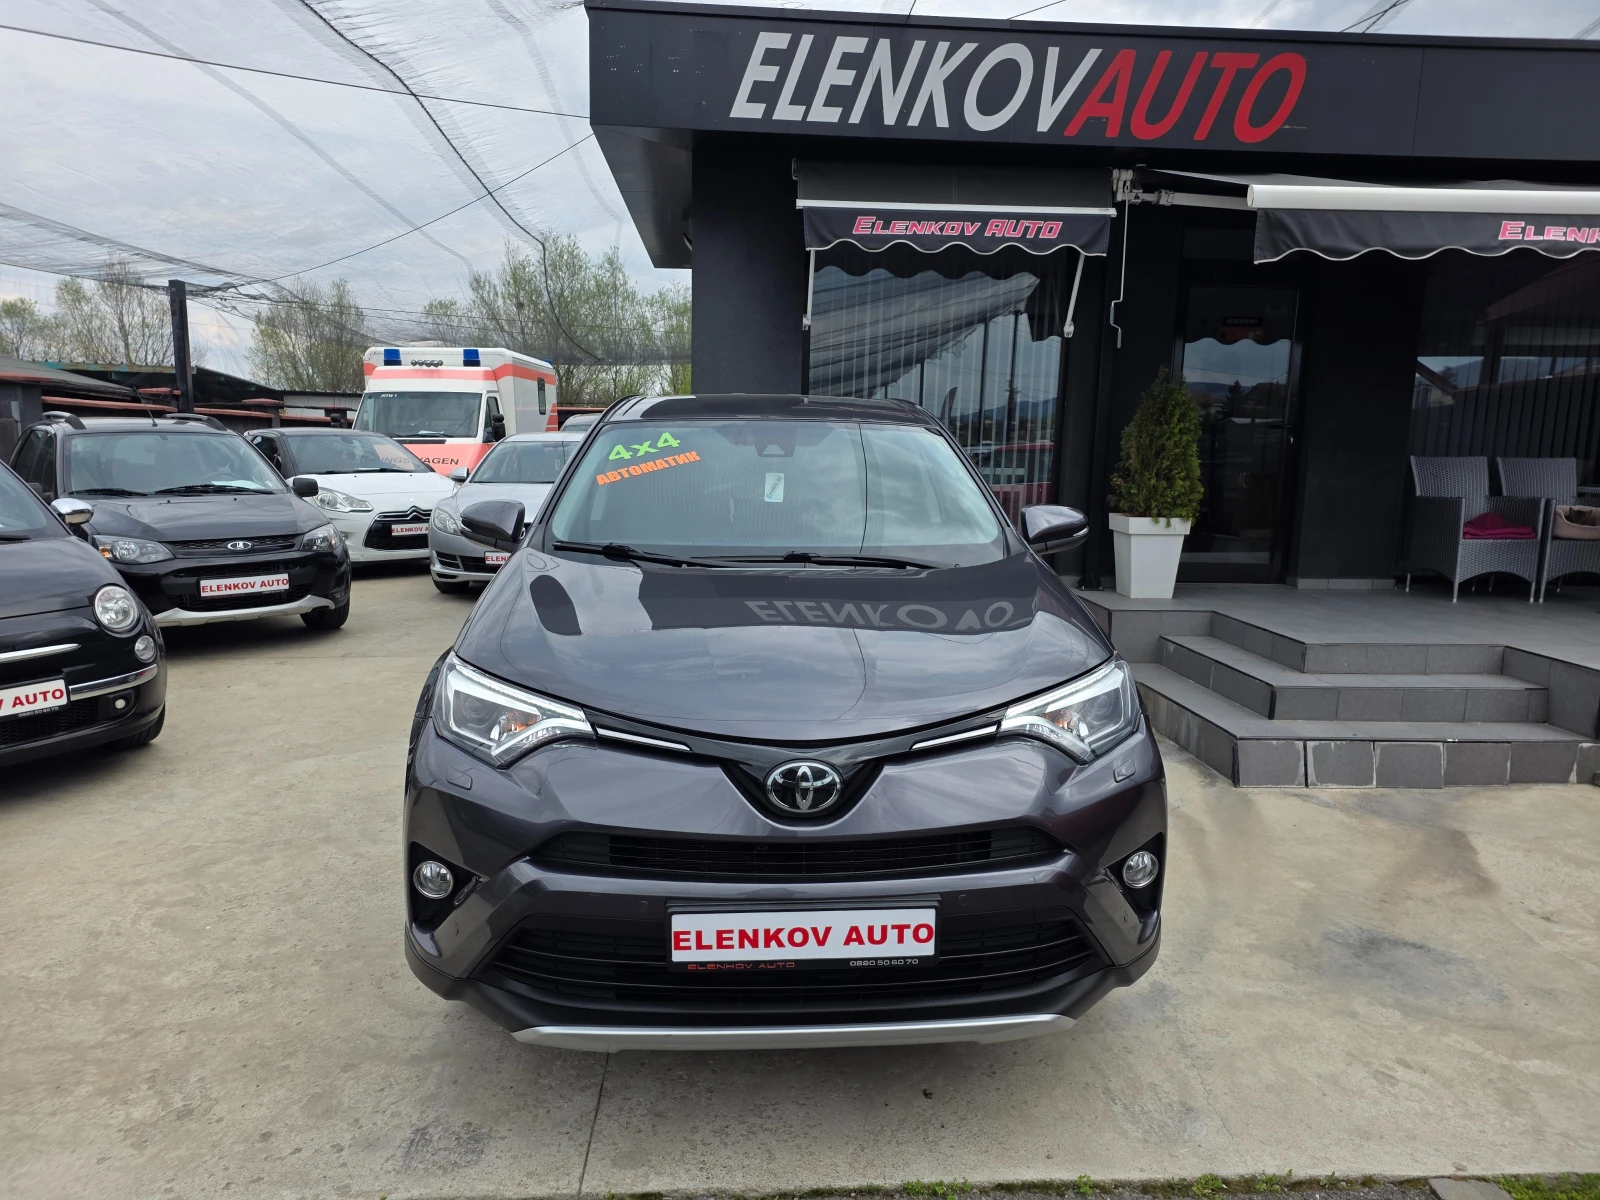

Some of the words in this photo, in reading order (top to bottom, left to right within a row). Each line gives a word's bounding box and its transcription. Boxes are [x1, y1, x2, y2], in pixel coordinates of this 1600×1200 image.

[852, 216, 981, 236] ELENKOV
[984, 218, 1063, 239] AUTO
[608, 432, 681, 460] 4x4
[596, 450, 701, 486] АВТОМАТИК
[392, 526, 423, 534] ELENKOV
[201, 581, 256, 593] ELENKOV
[260, 578, 289, 588] AUTO
[12, 688, 64, 708] AUTO
[673, 926, 832, 951] ELENKOV
[842, 923, 934, 946] AUTO
[758, 961, 795, 969] AUTO
